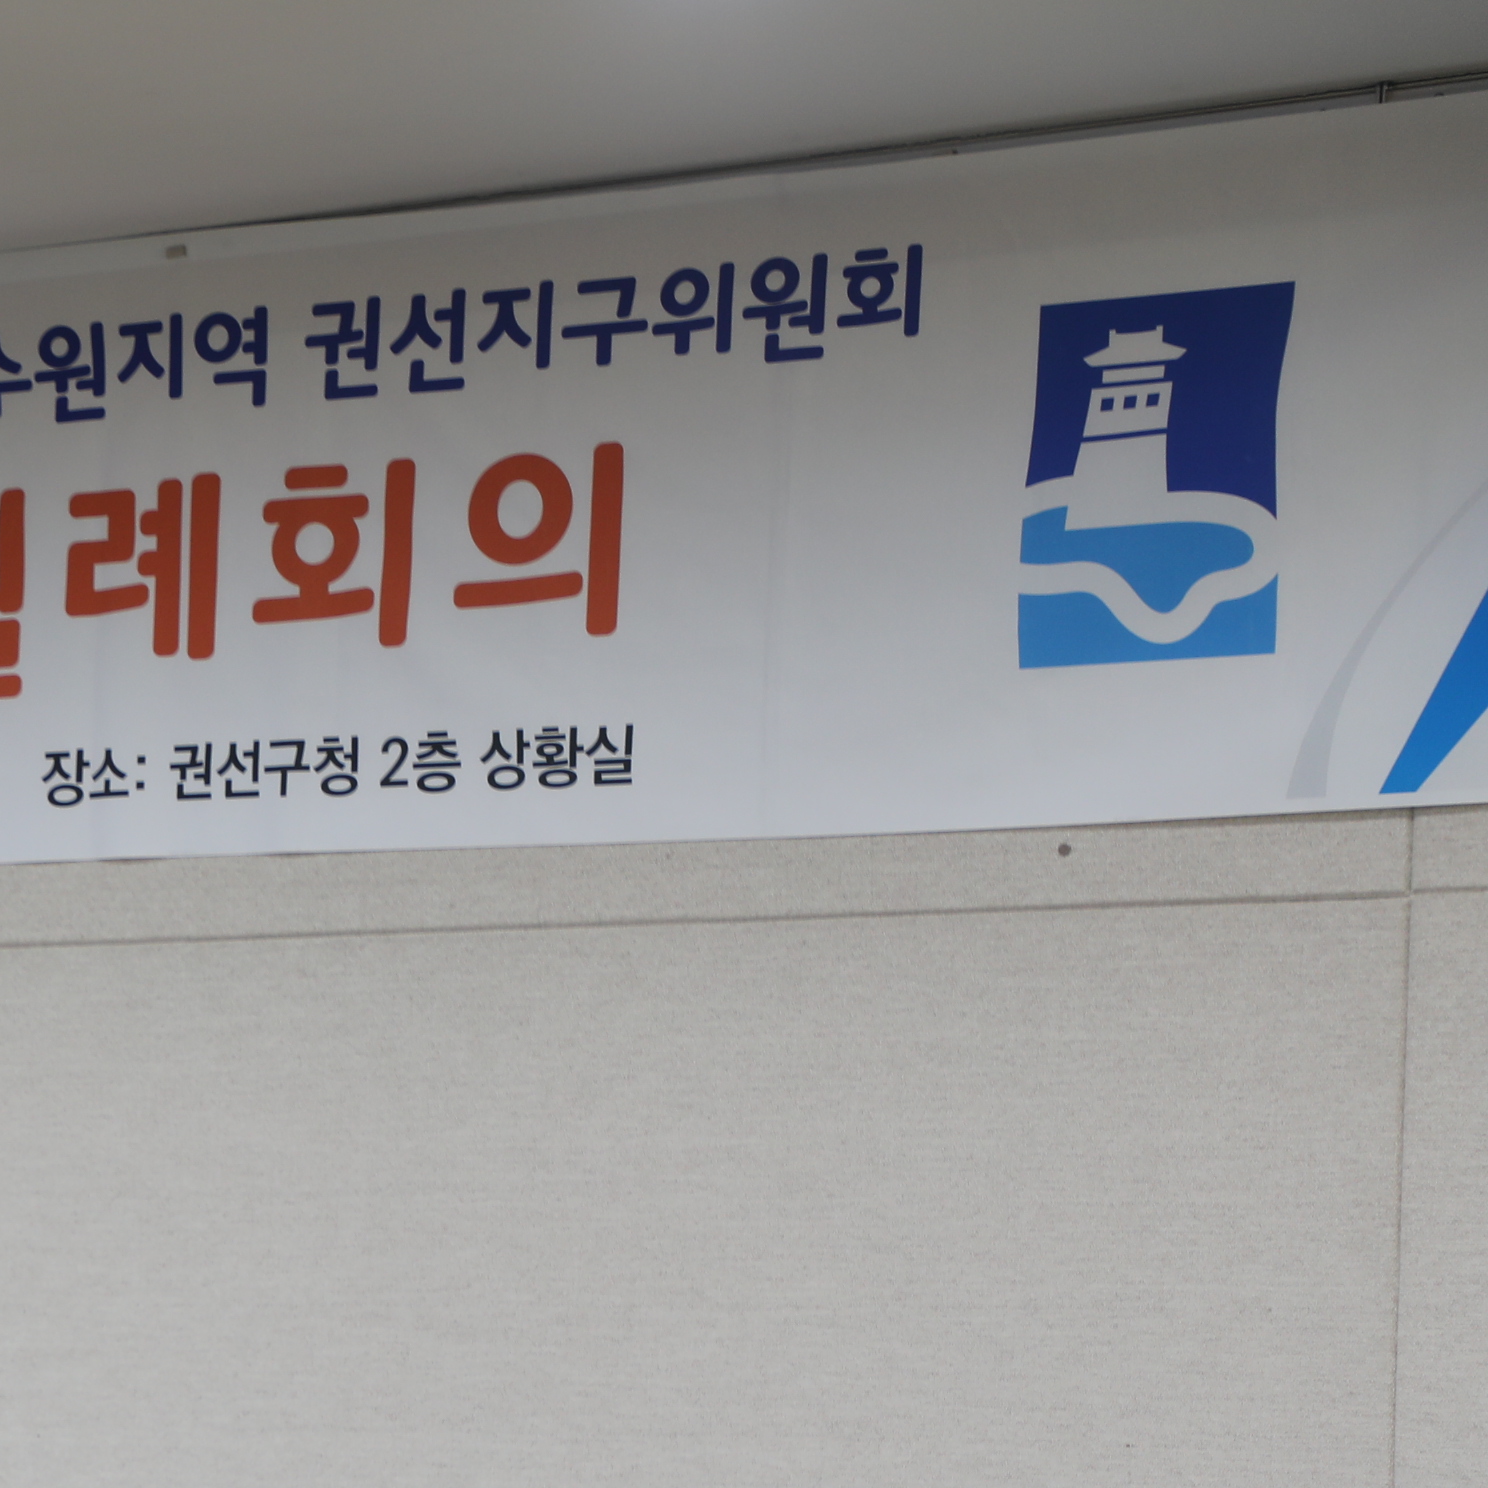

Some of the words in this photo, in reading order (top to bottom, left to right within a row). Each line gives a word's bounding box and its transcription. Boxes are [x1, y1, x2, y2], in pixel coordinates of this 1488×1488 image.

[303, 242, 925, 402] 권선지구위원회
[41, 748, 146, 808] 장소:
[169, 735, 360, 801] 권선구청
[379, 730, 462, 794] 2층
[479, 723, 635, 790] 상황실
